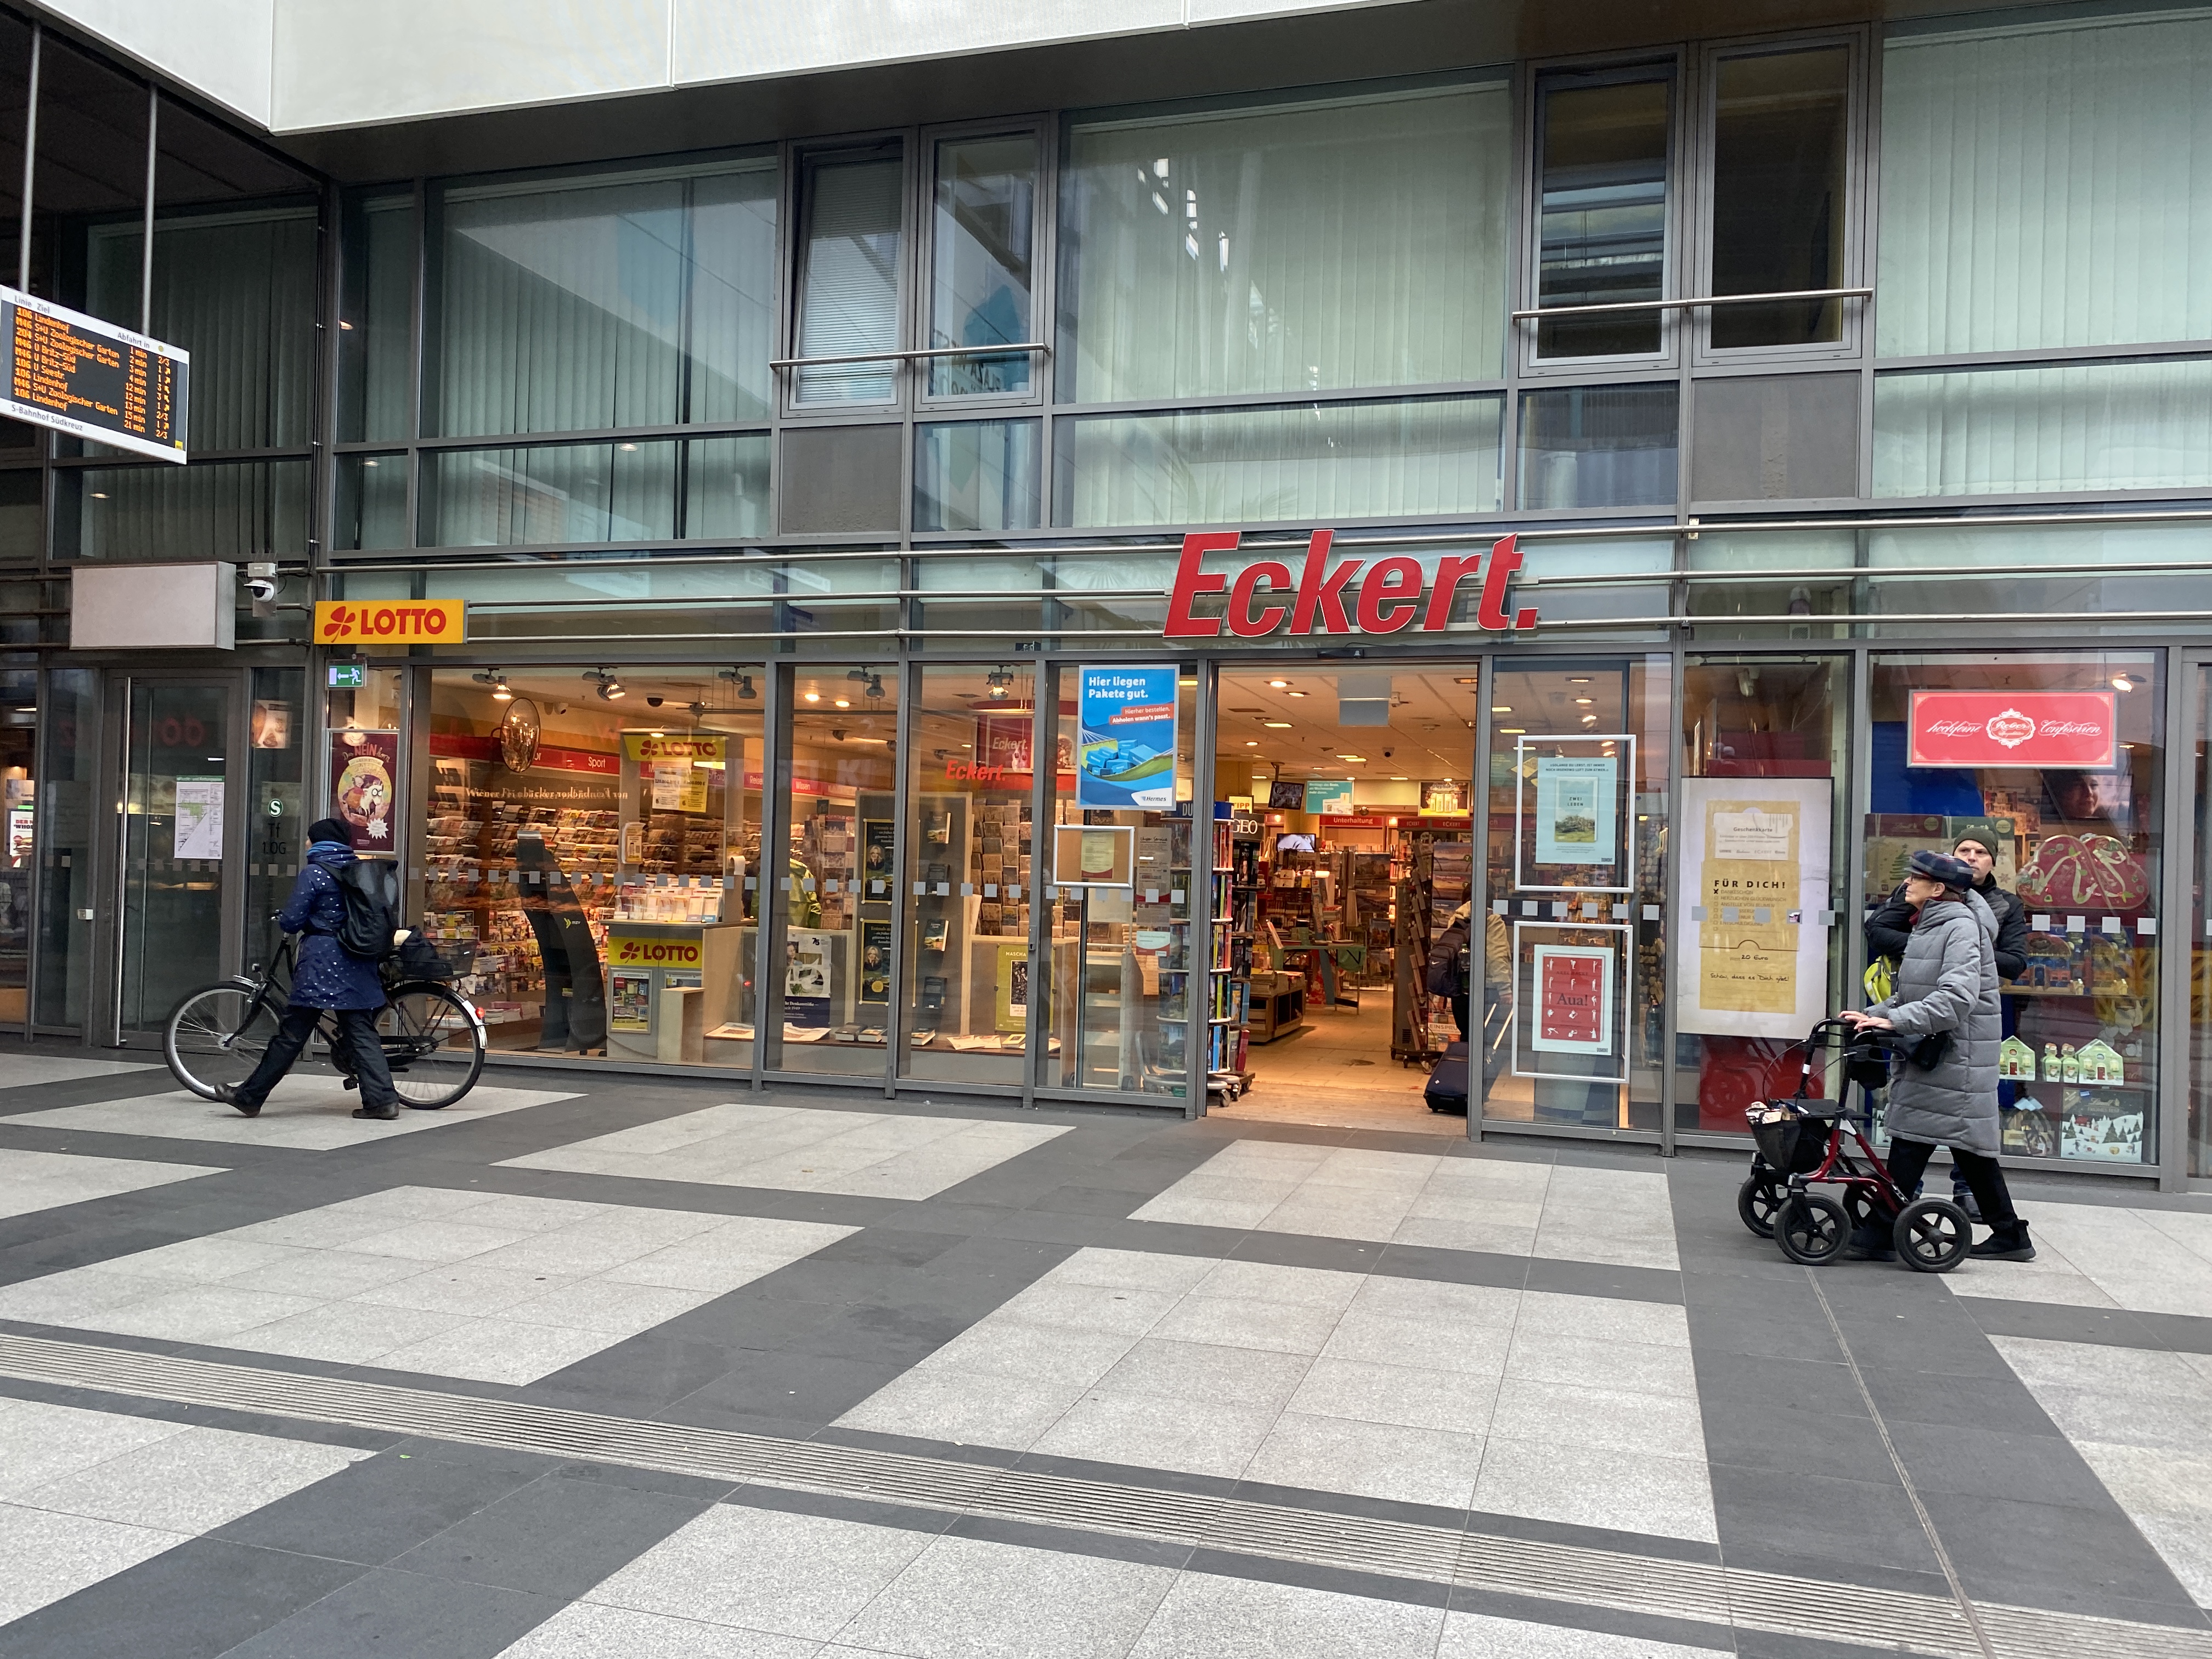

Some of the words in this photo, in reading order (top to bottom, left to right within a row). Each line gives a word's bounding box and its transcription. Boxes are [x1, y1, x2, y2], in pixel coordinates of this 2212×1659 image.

[15, 296, 32, 308] Linie
[37, 303, 50, 314] Ziel
[16, 317, 32, 329] M46
[35, 324, 48, 334] S+U
[51, 328, 95, 350] Zoologischer
[97, 345, 119, 358] Garten
[135, 358, 147, 368] min
[17, 307, 32, 319] 106
[35, 313, 69, 333] Lindenhof
[136, 348, 147, 358] min
[159, 357, 170, 365] 2/3
[117, 332, 143, 347] Abfahrt
[15, 337, 31, 349] M46
[35, 343, 39, 352] U
[42, 346, 76, 363] Britz-Süd
[134, 377, 146, 386] min
[16, 327, 32, 339] 204
[35, 333, 48, 344] S+U
[50, 337, 94, 360] Zoologischer
[97, 354, 119, 368] Garten
[135, 368, 146, 377] min
[15, 347, 31, 359] M46
[34, 353, 39, 362] U
[41, 356, 76, 374] Britz-Süd
[126, 383, 133, 391] 12
[134, 386, 146, 396] min
[16, 357, 31, 369] 106
[33, 363, 38, 371] U
[41, 365, 65, 380] Seestr.
[134, 396, 145, 405] min
[14, 377, 30, 390] M46
[33, 383, 46, 394] S+U
[49, 387, 93, 409] Zoologischer
[95, 402, 117, 415] Garten
[125, 411, 133, 420] 15
[133, 414, 145, 424] min
[15, 368, 31, 380] 106
[33, 373, 67, 392] Lindenhof
[125, 402, 133, 410] 13
[134, 405, 145, 414] min
[156, 411, 168, 421] 2/3
[12, 404, 49, 422] S-Bahnhof
[51, 415, 83, 431] Südkreuz
[14, 387, 30, 399] 106
[32, 393, 67, 411] Lindenhof
[125, 420, 132, 428] 21
[133, 423, 145, 433] min
[156, 430, 167, 439] 2/3
[1163, 529, 1539, 637] Eckert.
[361, 608, 446, 635] LOTTO
[1089, 676, 1110, 686] Hier
[1113, 676, 1146, 688] liegen
[1089, 689, 1125, 698] Pakete
[1127, 690, 1148, 700] gut.
[2038, 720, 2102, 737] Confiserien
[661, 741, 717, 756] LOTTO
[992, 737, 1028, 750] Eckert.
[588, 757, 606, 768] Sport
[945, 760, 1005, 781] Eckert.
[795, 781, 810, 791] Wissen
[1233, 819, 1258, 834] GEO
[1714, 878, 1738, 888] FÜR
[1747, 881, 1785, 889] DICH!
[644, 944, 698, 962] LOTTO
[1556, 994, 1588, 1006] Aua!
